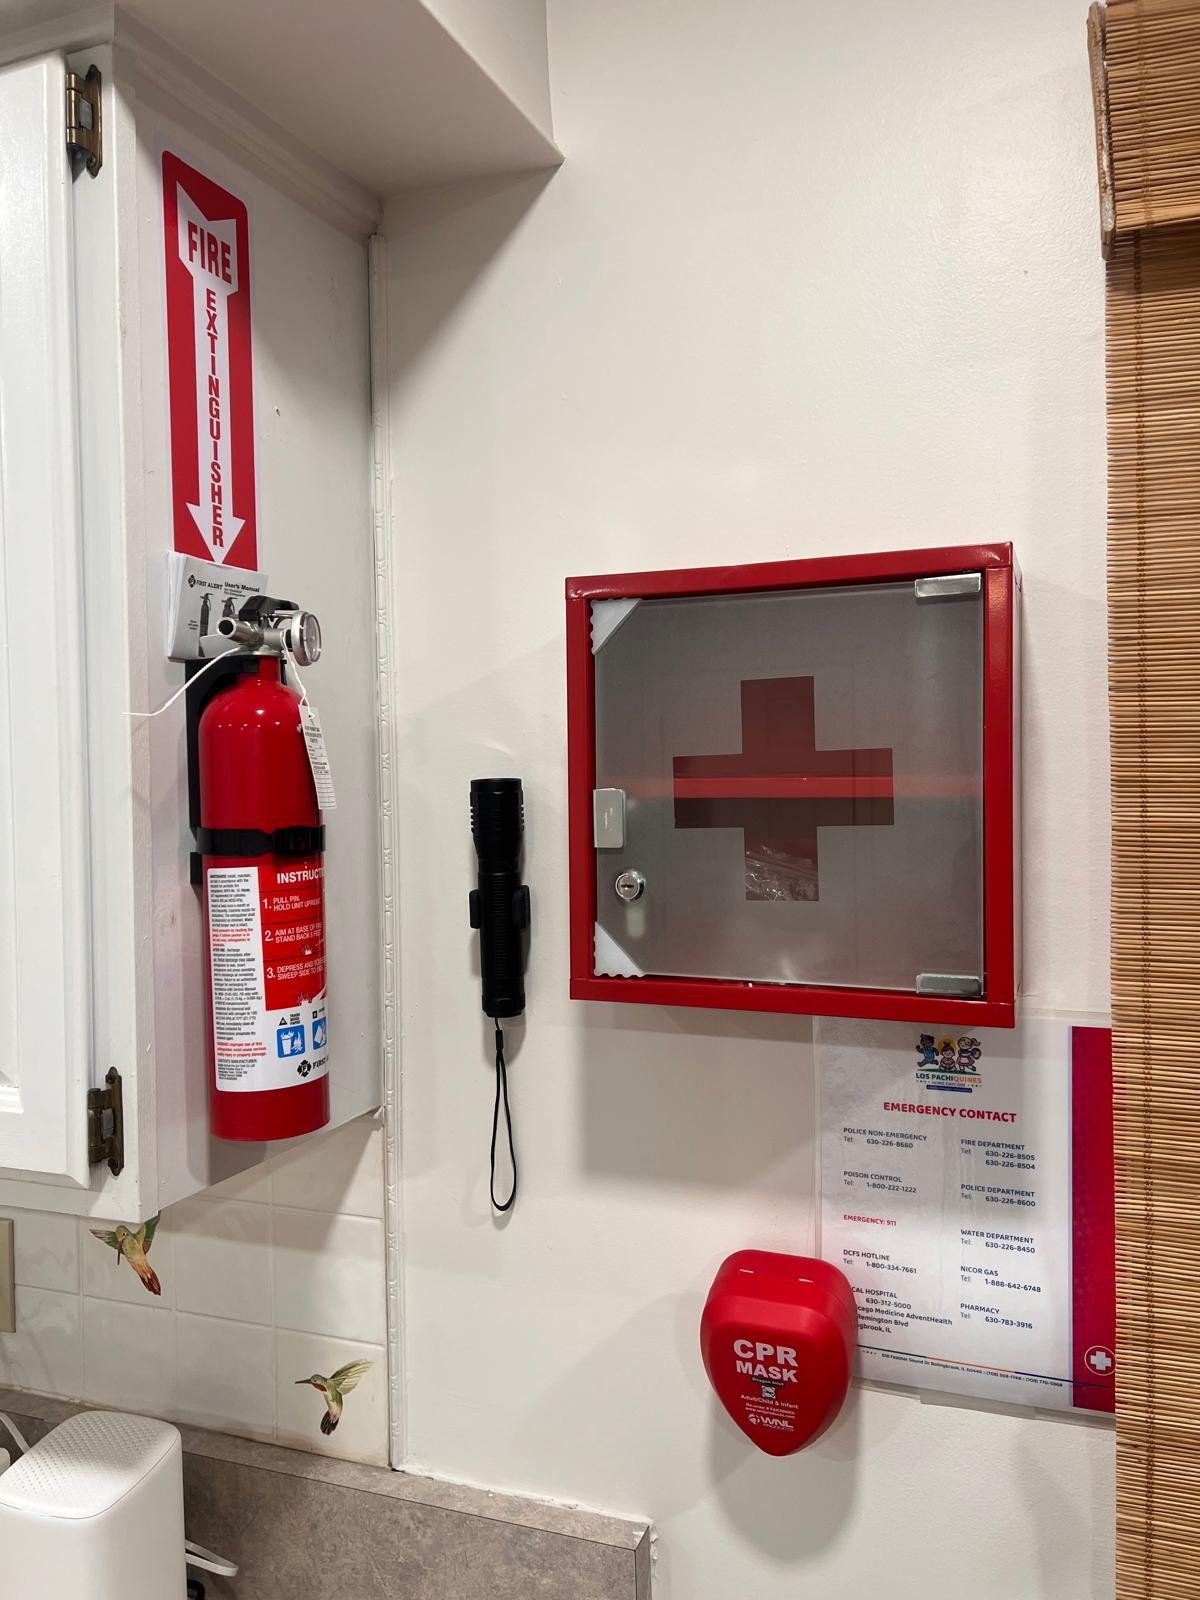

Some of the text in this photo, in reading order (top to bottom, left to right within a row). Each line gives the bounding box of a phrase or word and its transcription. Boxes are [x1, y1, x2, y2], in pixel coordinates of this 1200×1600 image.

[188, 221, 232, 285] FIRE
[205, 288, 224, 548] EXTINGUISHER
[208, 582, 223, 590] ALERT
[225, 582, 240, 590] User's
[262, 898, 272, 910] 1.
[273, 896, 288, 904] PULL
[274, 903, 290, 912] HOLD
[292, 901, 304, 910] UNIT
[264, 930, 274, 942] 2.
[275, 928, 286, 936] AIM
[288, 926, 295, 934] AT
[296, 924, 309, 933] BASE
[276, 934, 295, 944] STAND
[296, 932, 310, 940] BACK
[267, 968, 276, 979] 3.
[277, 964, 303, 974] DEPRESS
[278, 971, 298, 980] SWEEP
[932, 1074, 982, 1084] PACHIQUINES
[884, 1102, 1016, 1123] EMERGENCY CONTACT
[844, 1128, 927, 1141] POLICE NON-EMERGENCY
[961, 1139, 1025, 1150] FIRE DEPARTMENT
[985, 1150, 1035, 1161] 630-226-8505
[985, 1159, 1035, 1170] 630-226-8504
[844, 1170, 902, 1183] POISON CONTROL
[866, 1182, 917, 1193] 1-800-222-1222
[961, 1184, 1035, 1198] POLICE DEPARTMENT
[985, 1196, 1035, 1207] 630-226-8600
[844, 1214, 885, 1226] EMERGENCY:
[960, 1228, 1034, 1244] WATER DEPARTMENT
[985, 1241, 1035, 1254] 630-226-8450
[843, 1249, 890, 1261] DCFS HOTLINE
[866, 1261, 917, 1274] 1-800-334-7661
[960, 1266, 998, 1277] NICOR GAS
[985, 1278, 1041, 1293] 1-888-642-6748
[866, 1289, 897, 1298] HOSPITAL
[866, 1298, 911, 1309] 630-312-5000
[960, 1303, 1000, 1314] PHARMACY
[875, 1308, 904, 1317] Medicine
[906, 1313, 952, 1325] AdventHealth
[985, 1316, 1032, 1329] 630-783-3916
[858, 1324, 884, 1333] gbrook,
[733, 1339, 798, 1367] CPR
[736, 1360, 798, 1382] MASK
[740, 1394, 774, 1404] Adult/Child
[781, 1401, 799, 1409] Infant
